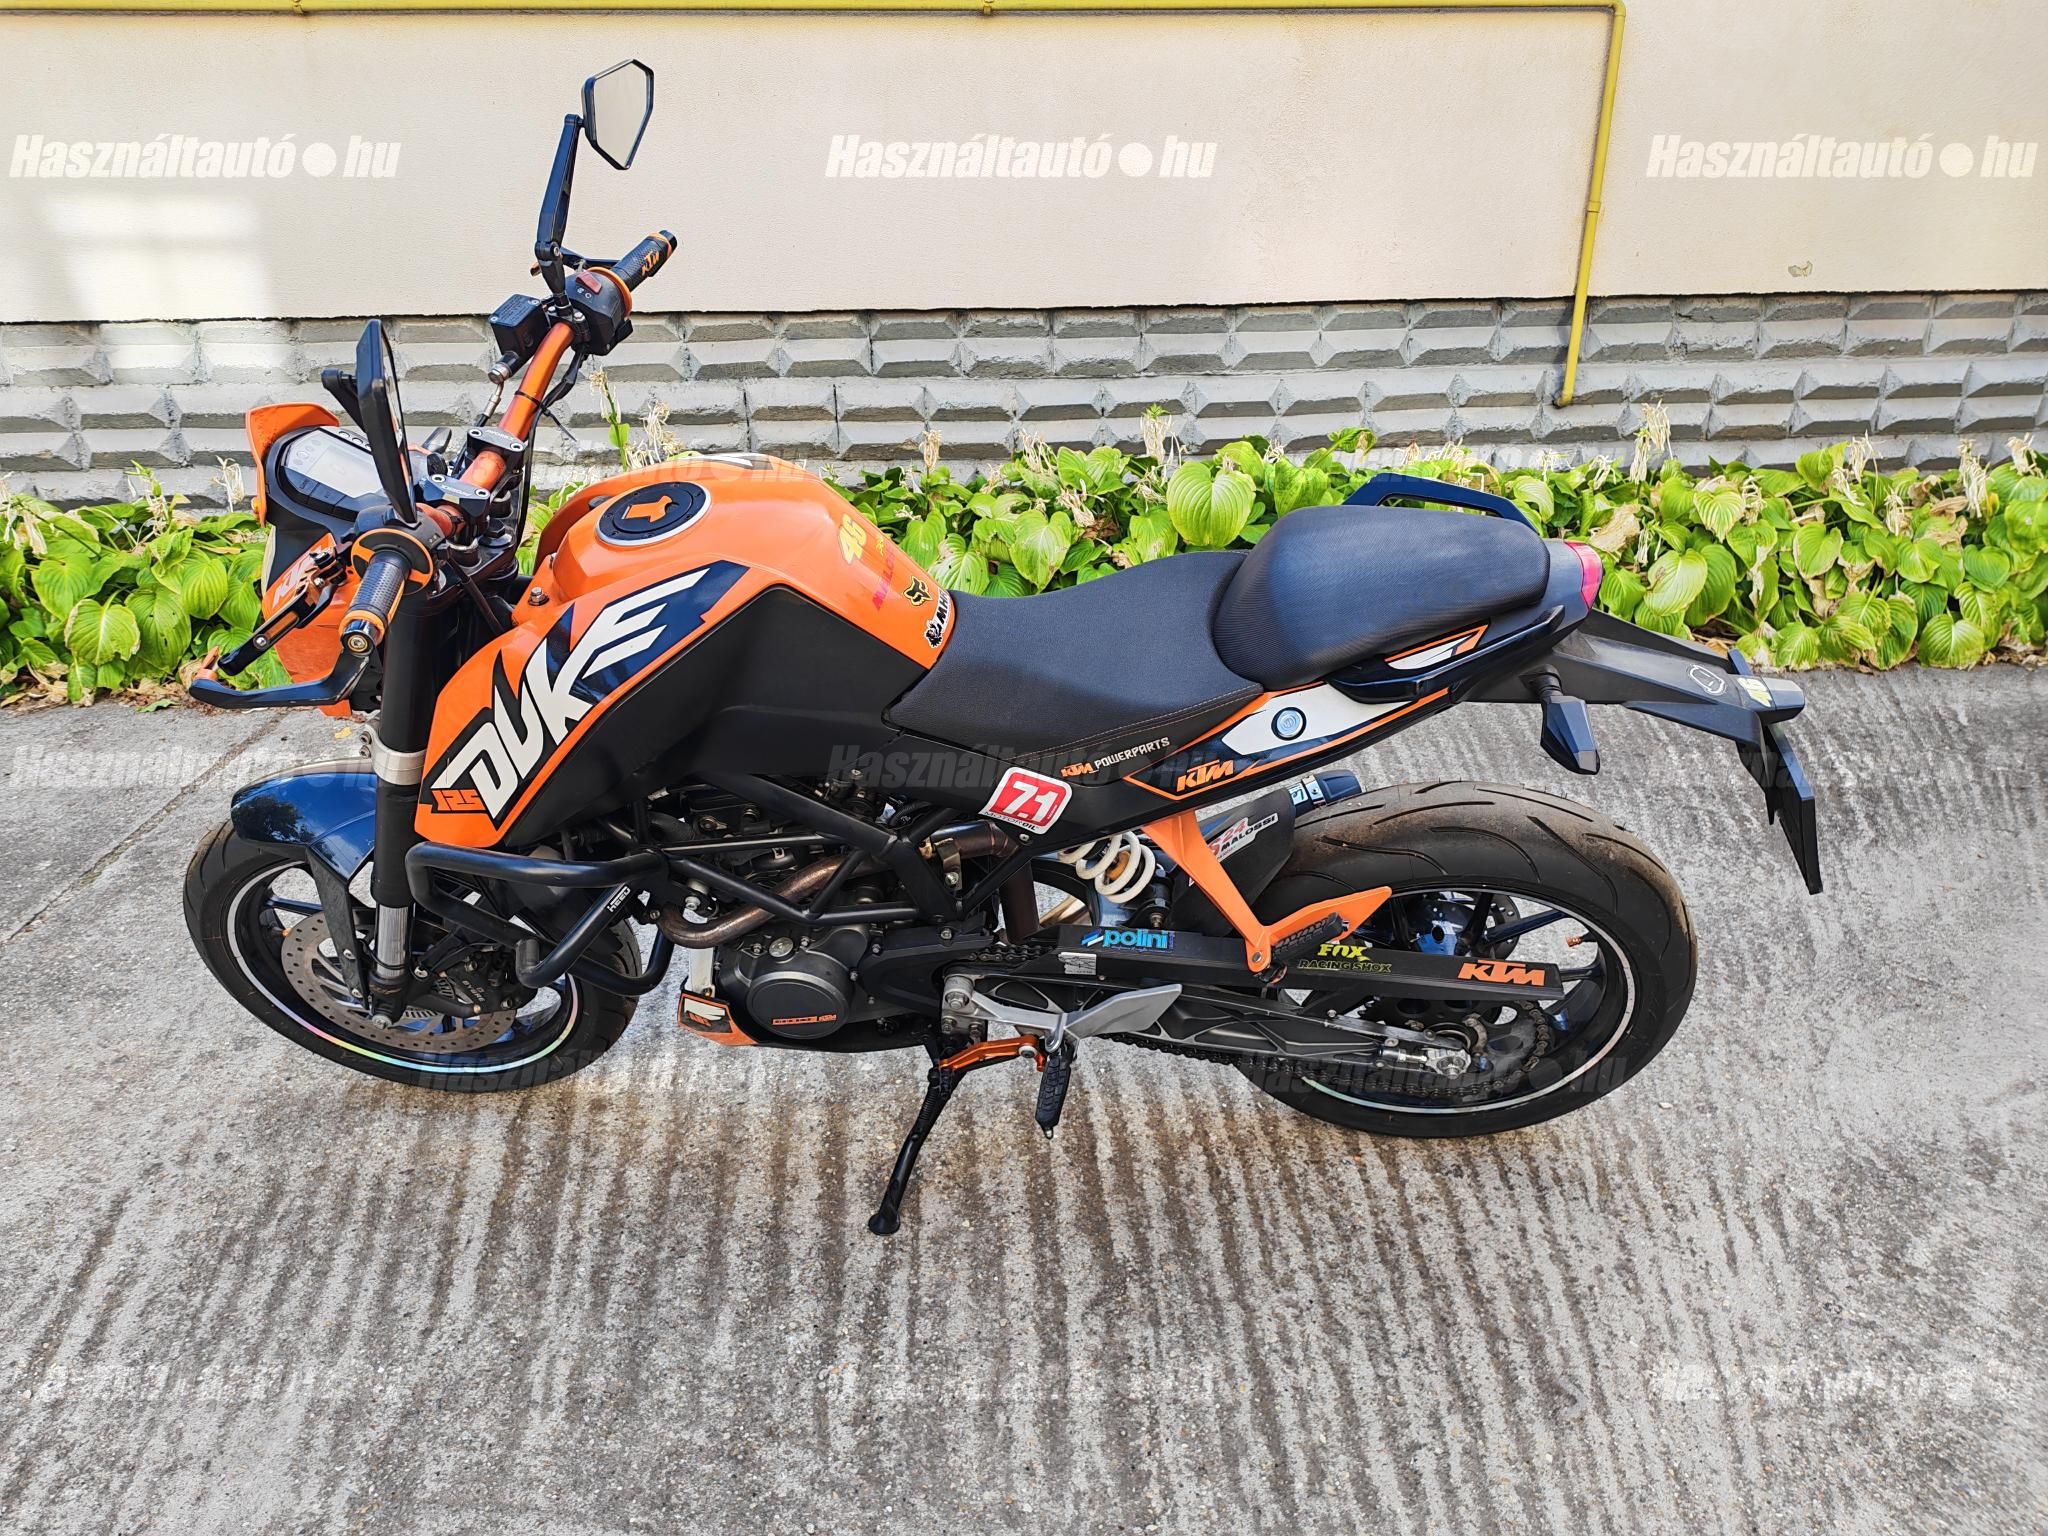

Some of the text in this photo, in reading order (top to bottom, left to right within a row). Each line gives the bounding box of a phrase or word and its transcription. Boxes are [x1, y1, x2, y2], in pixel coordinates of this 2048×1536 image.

[430, 567, 711, 820] DUKE
[1060, 736, 1170, 777] KTM POWERPARTS
[1176, 759, 1234, 792] KTM
[431, 789, 486, 811] 125
[1221, 815, 1276, 851] MALOSSI
[1102, 928, 1168, 948] polini
[1297, 959, 1393, 973] RACING SHOX
[1457, 959, 1545, 986] KTM
